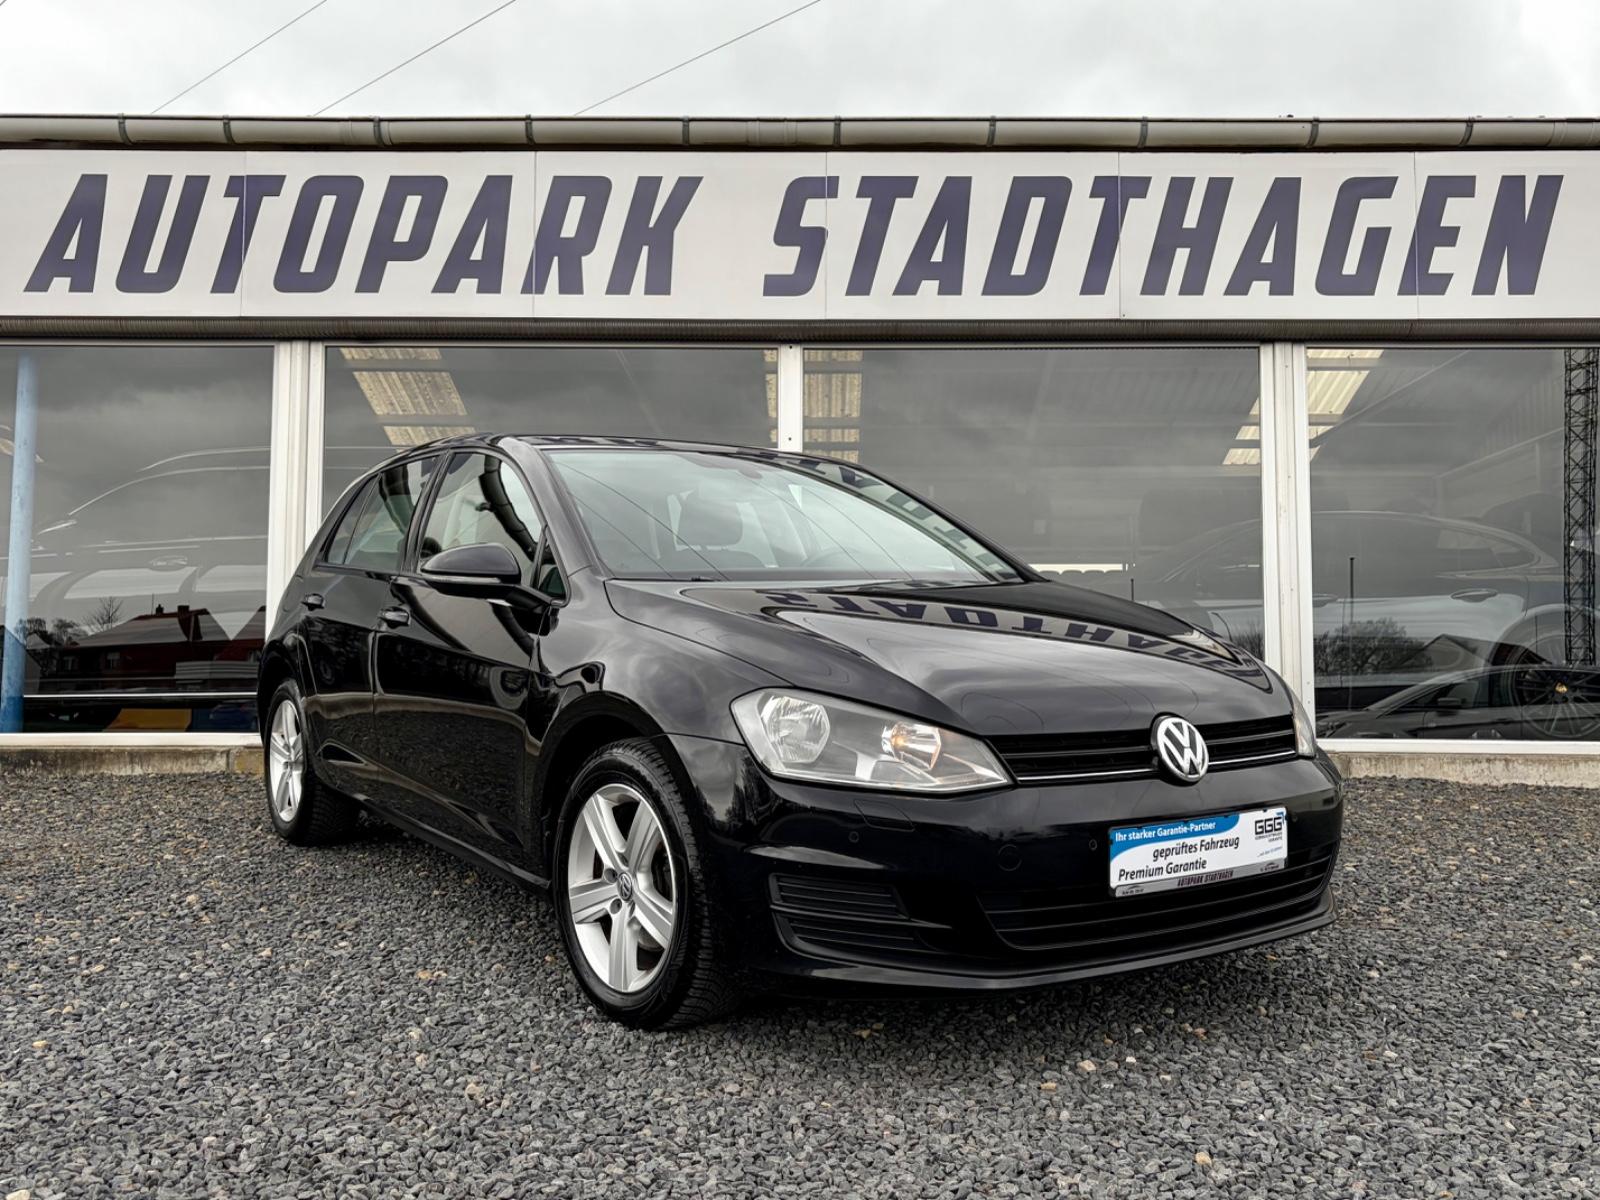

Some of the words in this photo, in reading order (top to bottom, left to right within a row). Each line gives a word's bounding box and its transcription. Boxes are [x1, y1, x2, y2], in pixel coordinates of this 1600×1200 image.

[23, 174, 703, 295] AUTOPARK
[763, 174, 1564, 296] STADTHAGEN
[1158, 718, 1208, 780] VW
[1115, 832, 1127, 842] Ihr
[1128, 828, 1156, 840] starker
[1157, 822, 1216, 837] Garantie-Partner
[1254, 816, 1283, 835] GGG
[1152, 843, 1198, 862] geprüftes
[1200, 836, 1239, 851] Fahrzeug
[1118, 866, 1163, 881] Premium
[1165, 859, 1207, 874] Garantie
